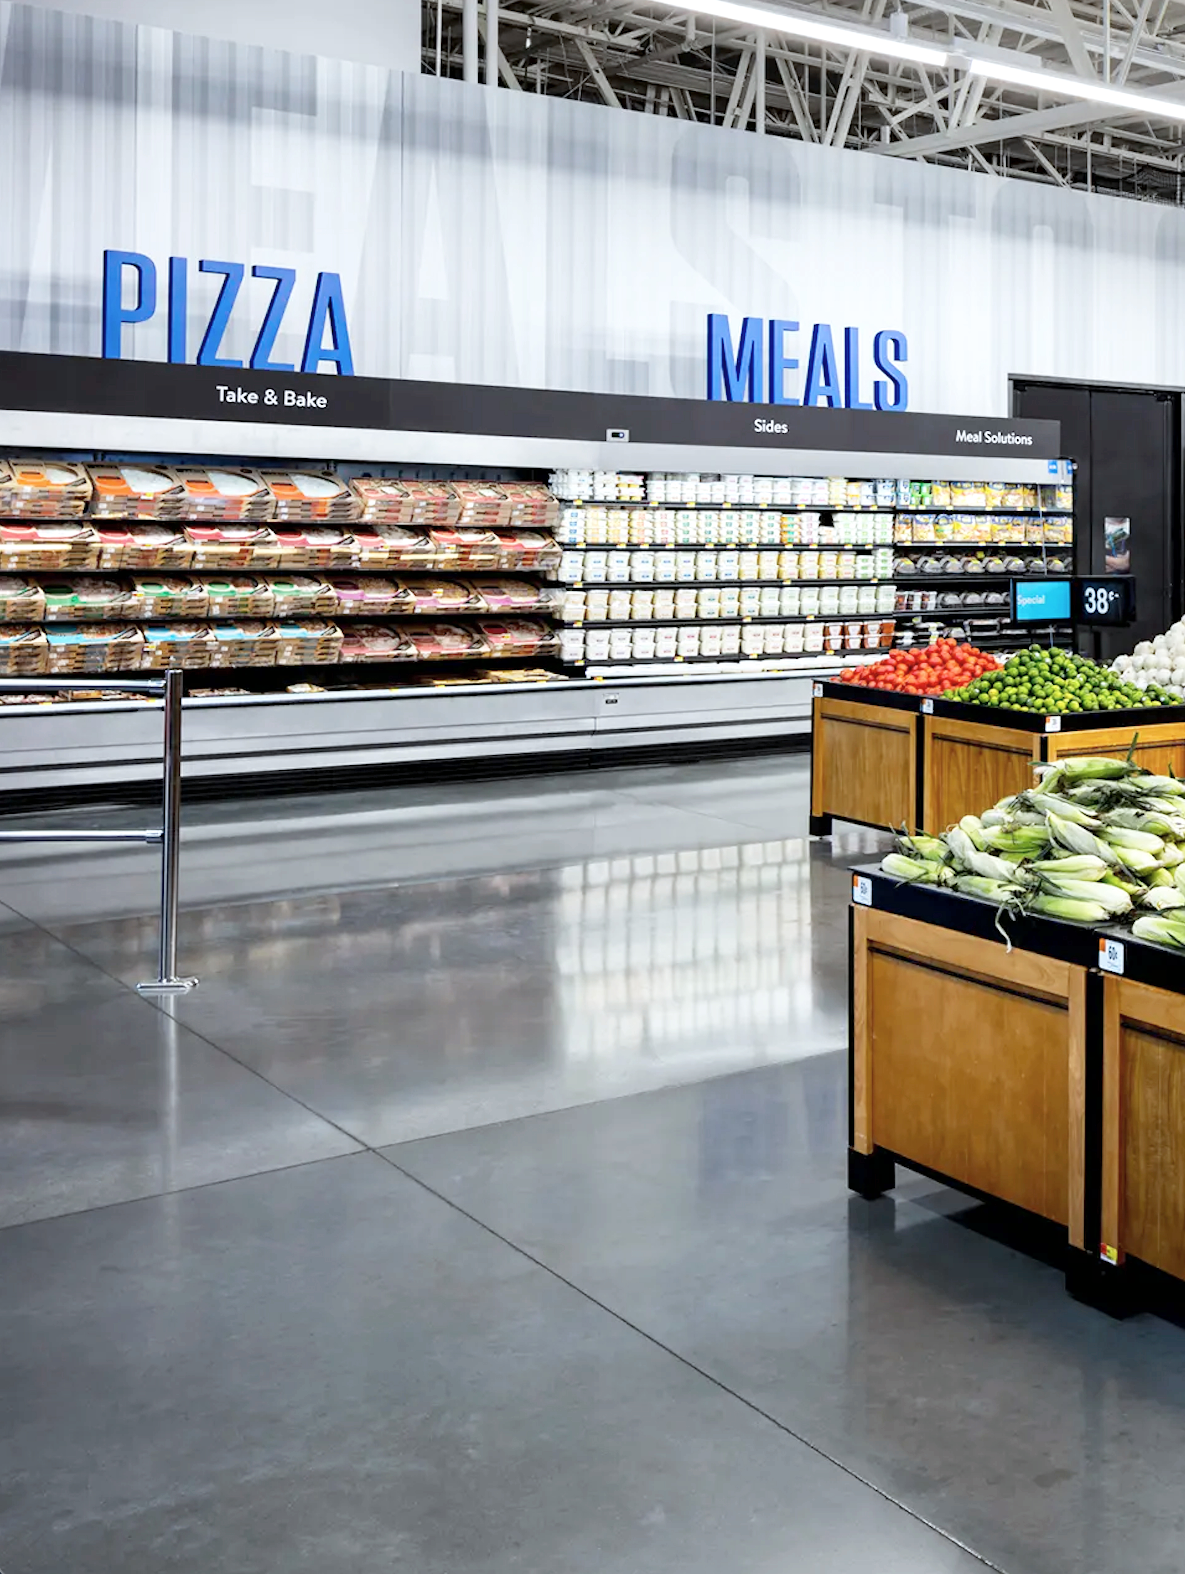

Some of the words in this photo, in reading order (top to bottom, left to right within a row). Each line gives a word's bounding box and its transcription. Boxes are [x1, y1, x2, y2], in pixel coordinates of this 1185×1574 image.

[102, 250, 355, 377] PIZZA
[706, 313, 909, 413] MEALS
[216, 386, 258, 405] Take
[264, 388, 279, 406] &
[283, 389, 328, 409] Bake
[753, 418, 789, 434] Sides
[955, 429, 983, 444] Meal
[985, 430, 1033, 447] Solutions
[1017, 594, 1046, 607] Special
